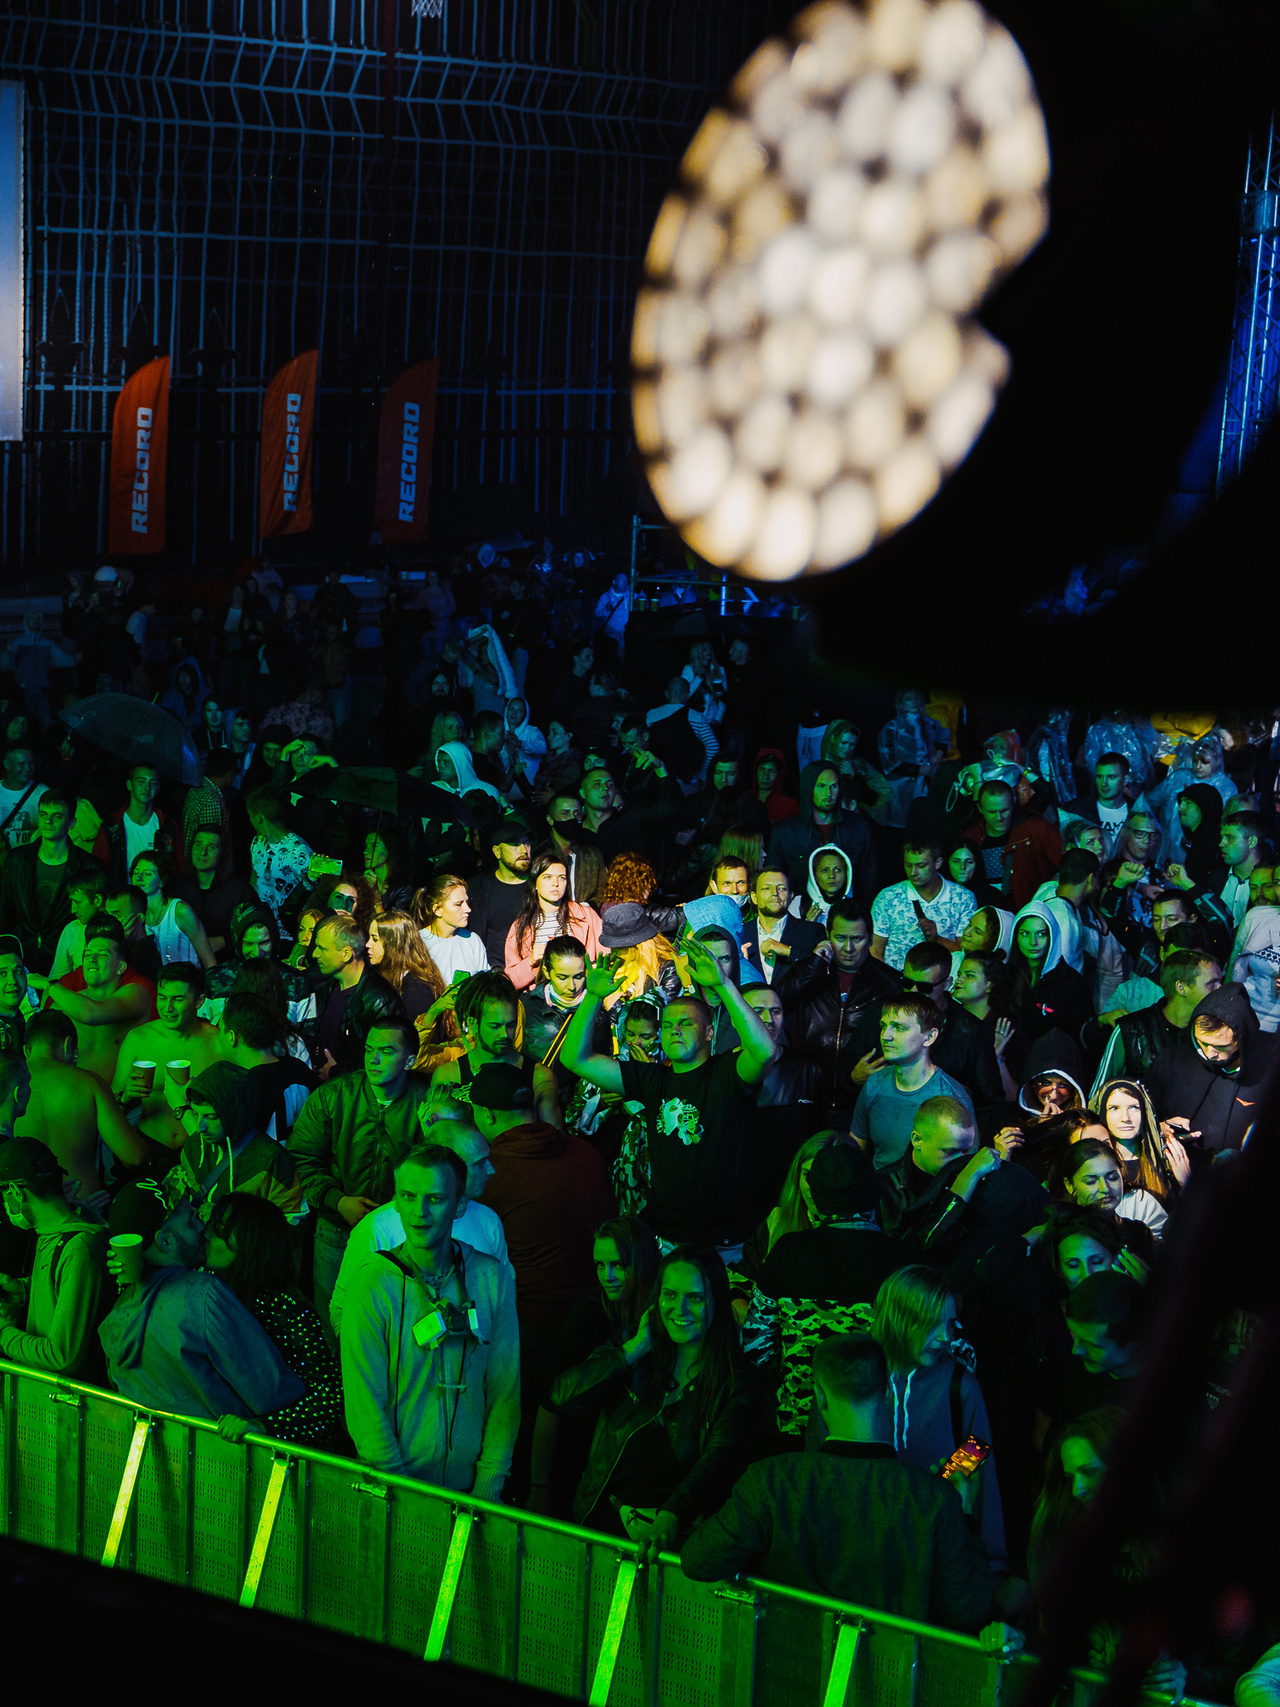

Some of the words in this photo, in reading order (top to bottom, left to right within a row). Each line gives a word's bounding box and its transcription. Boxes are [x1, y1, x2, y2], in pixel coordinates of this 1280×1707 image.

[131, 406, 153, 534] RECORD
[283, 393, 302, 512] RECORD
[398, 401, 420, 523] RECORD
